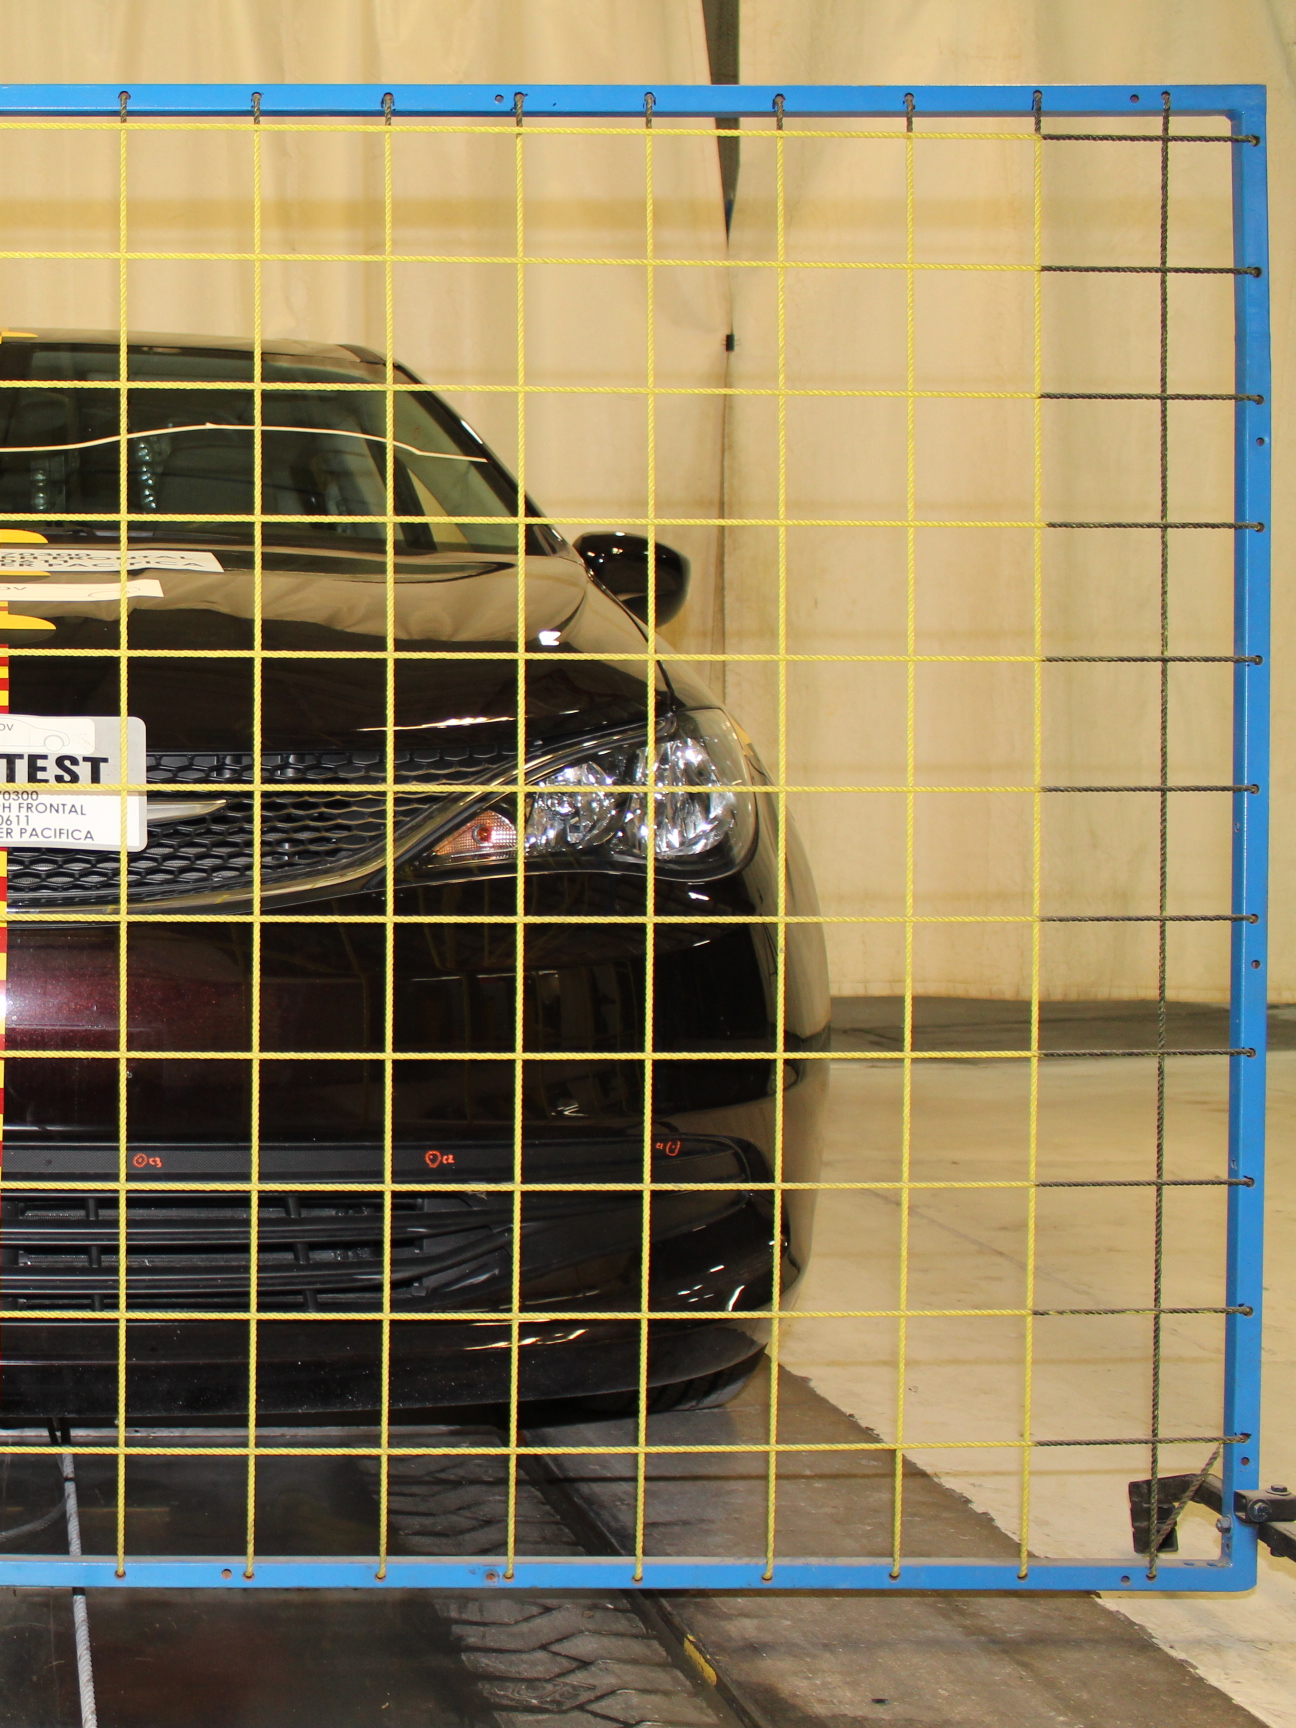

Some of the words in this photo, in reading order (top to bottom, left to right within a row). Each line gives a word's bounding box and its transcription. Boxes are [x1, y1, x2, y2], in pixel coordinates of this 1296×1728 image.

[48, 560, 205, 568] PACFICA
[18, 802, 87, 816] FRONTAL
[19, 827, 95, 842] PACIFICA
